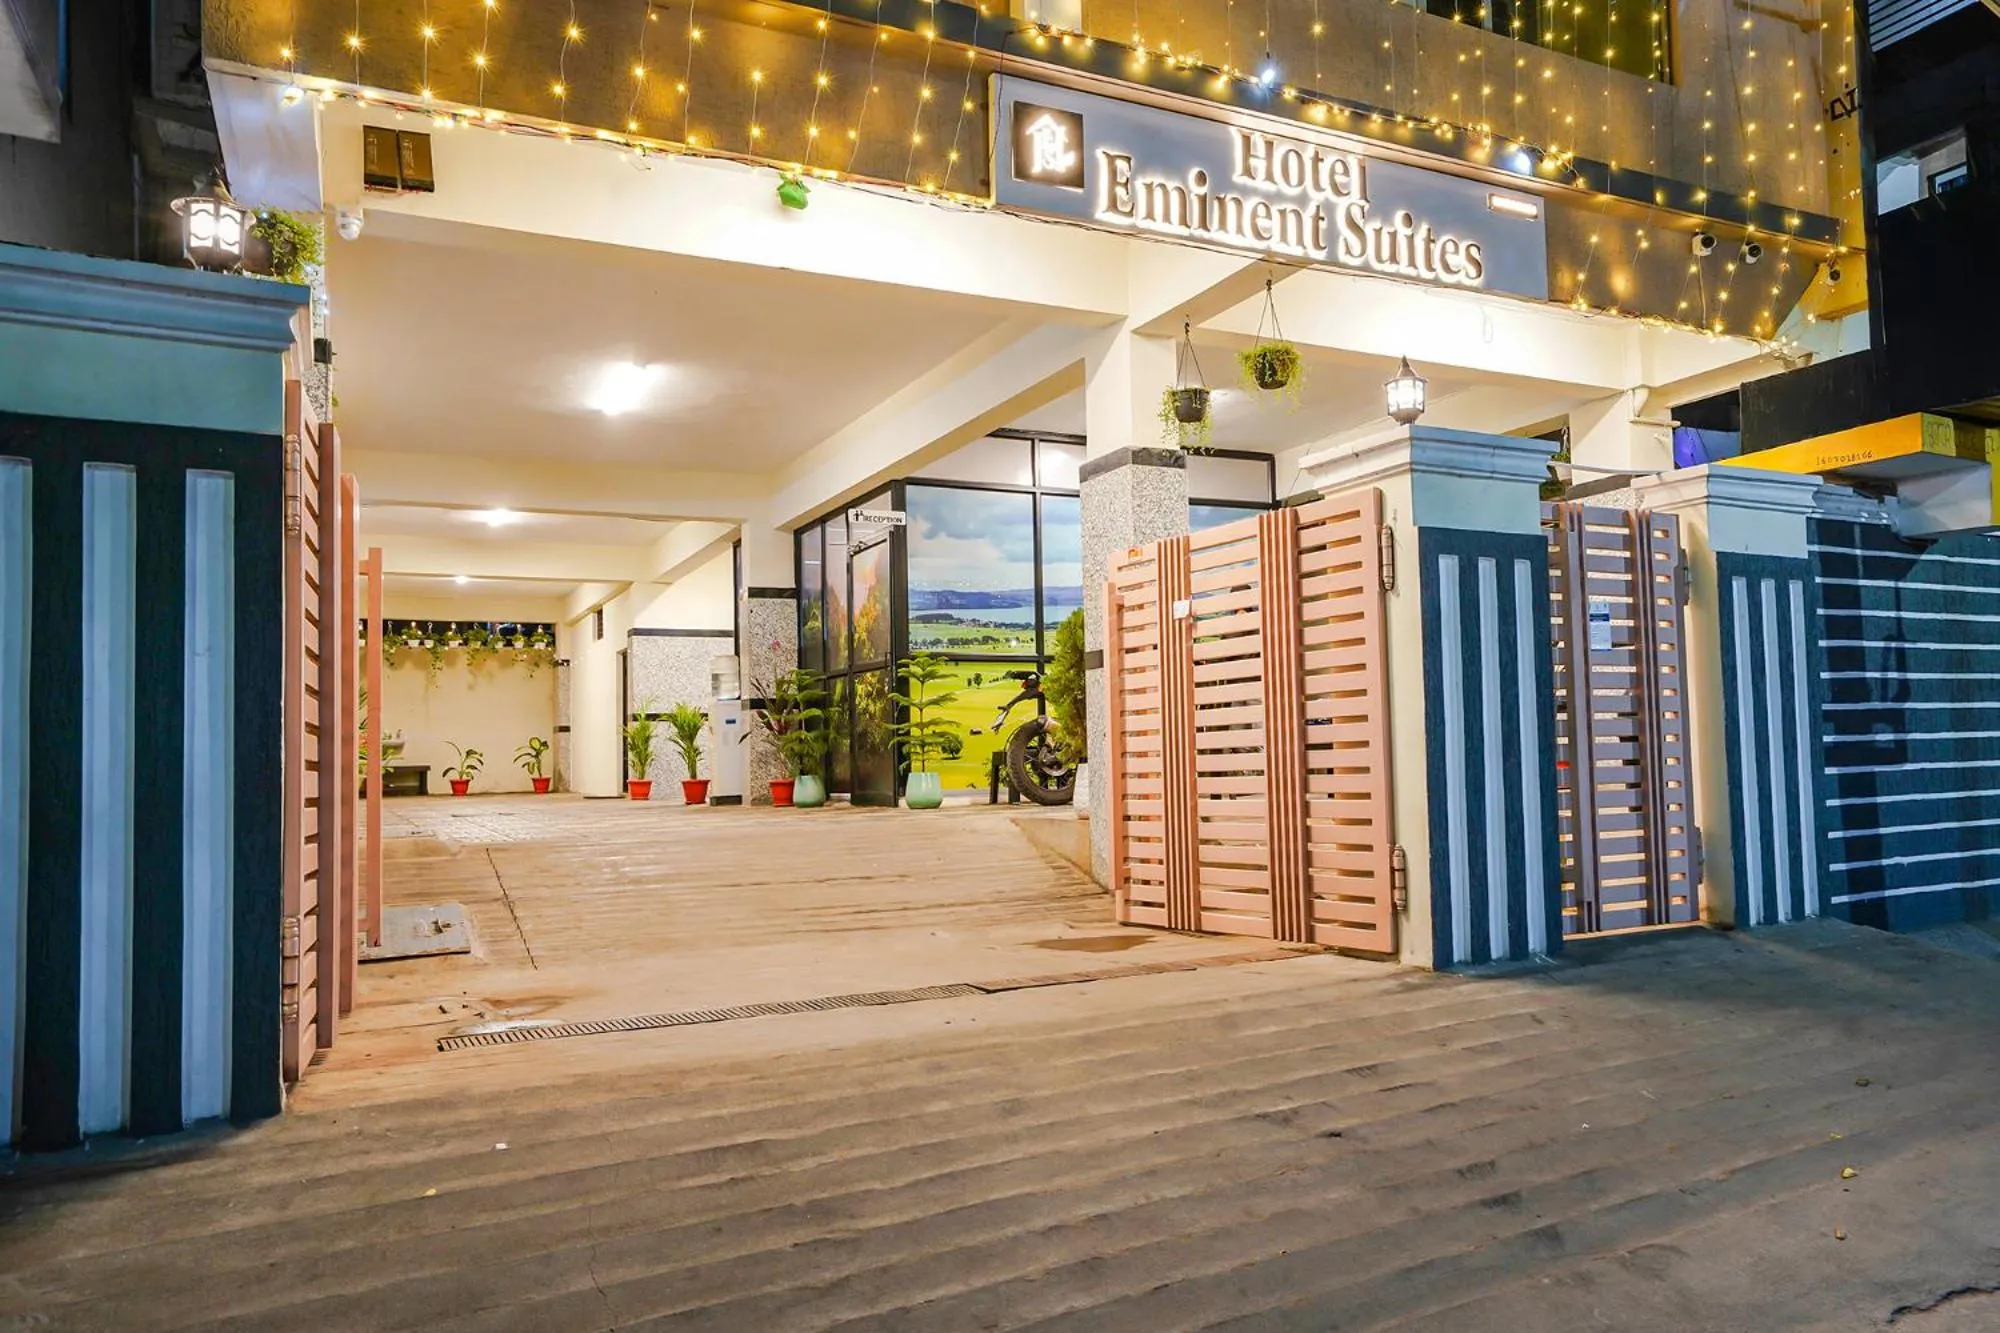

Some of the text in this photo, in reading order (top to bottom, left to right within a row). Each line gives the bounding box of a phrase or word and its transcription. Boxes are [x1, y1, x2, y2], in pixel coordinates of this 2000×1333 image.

[1232, 126, 1369, 203] Hotel
[1098, 149, 1483, 283] Eminent Suites
[863, 515, 903, 524] RECEPTION
